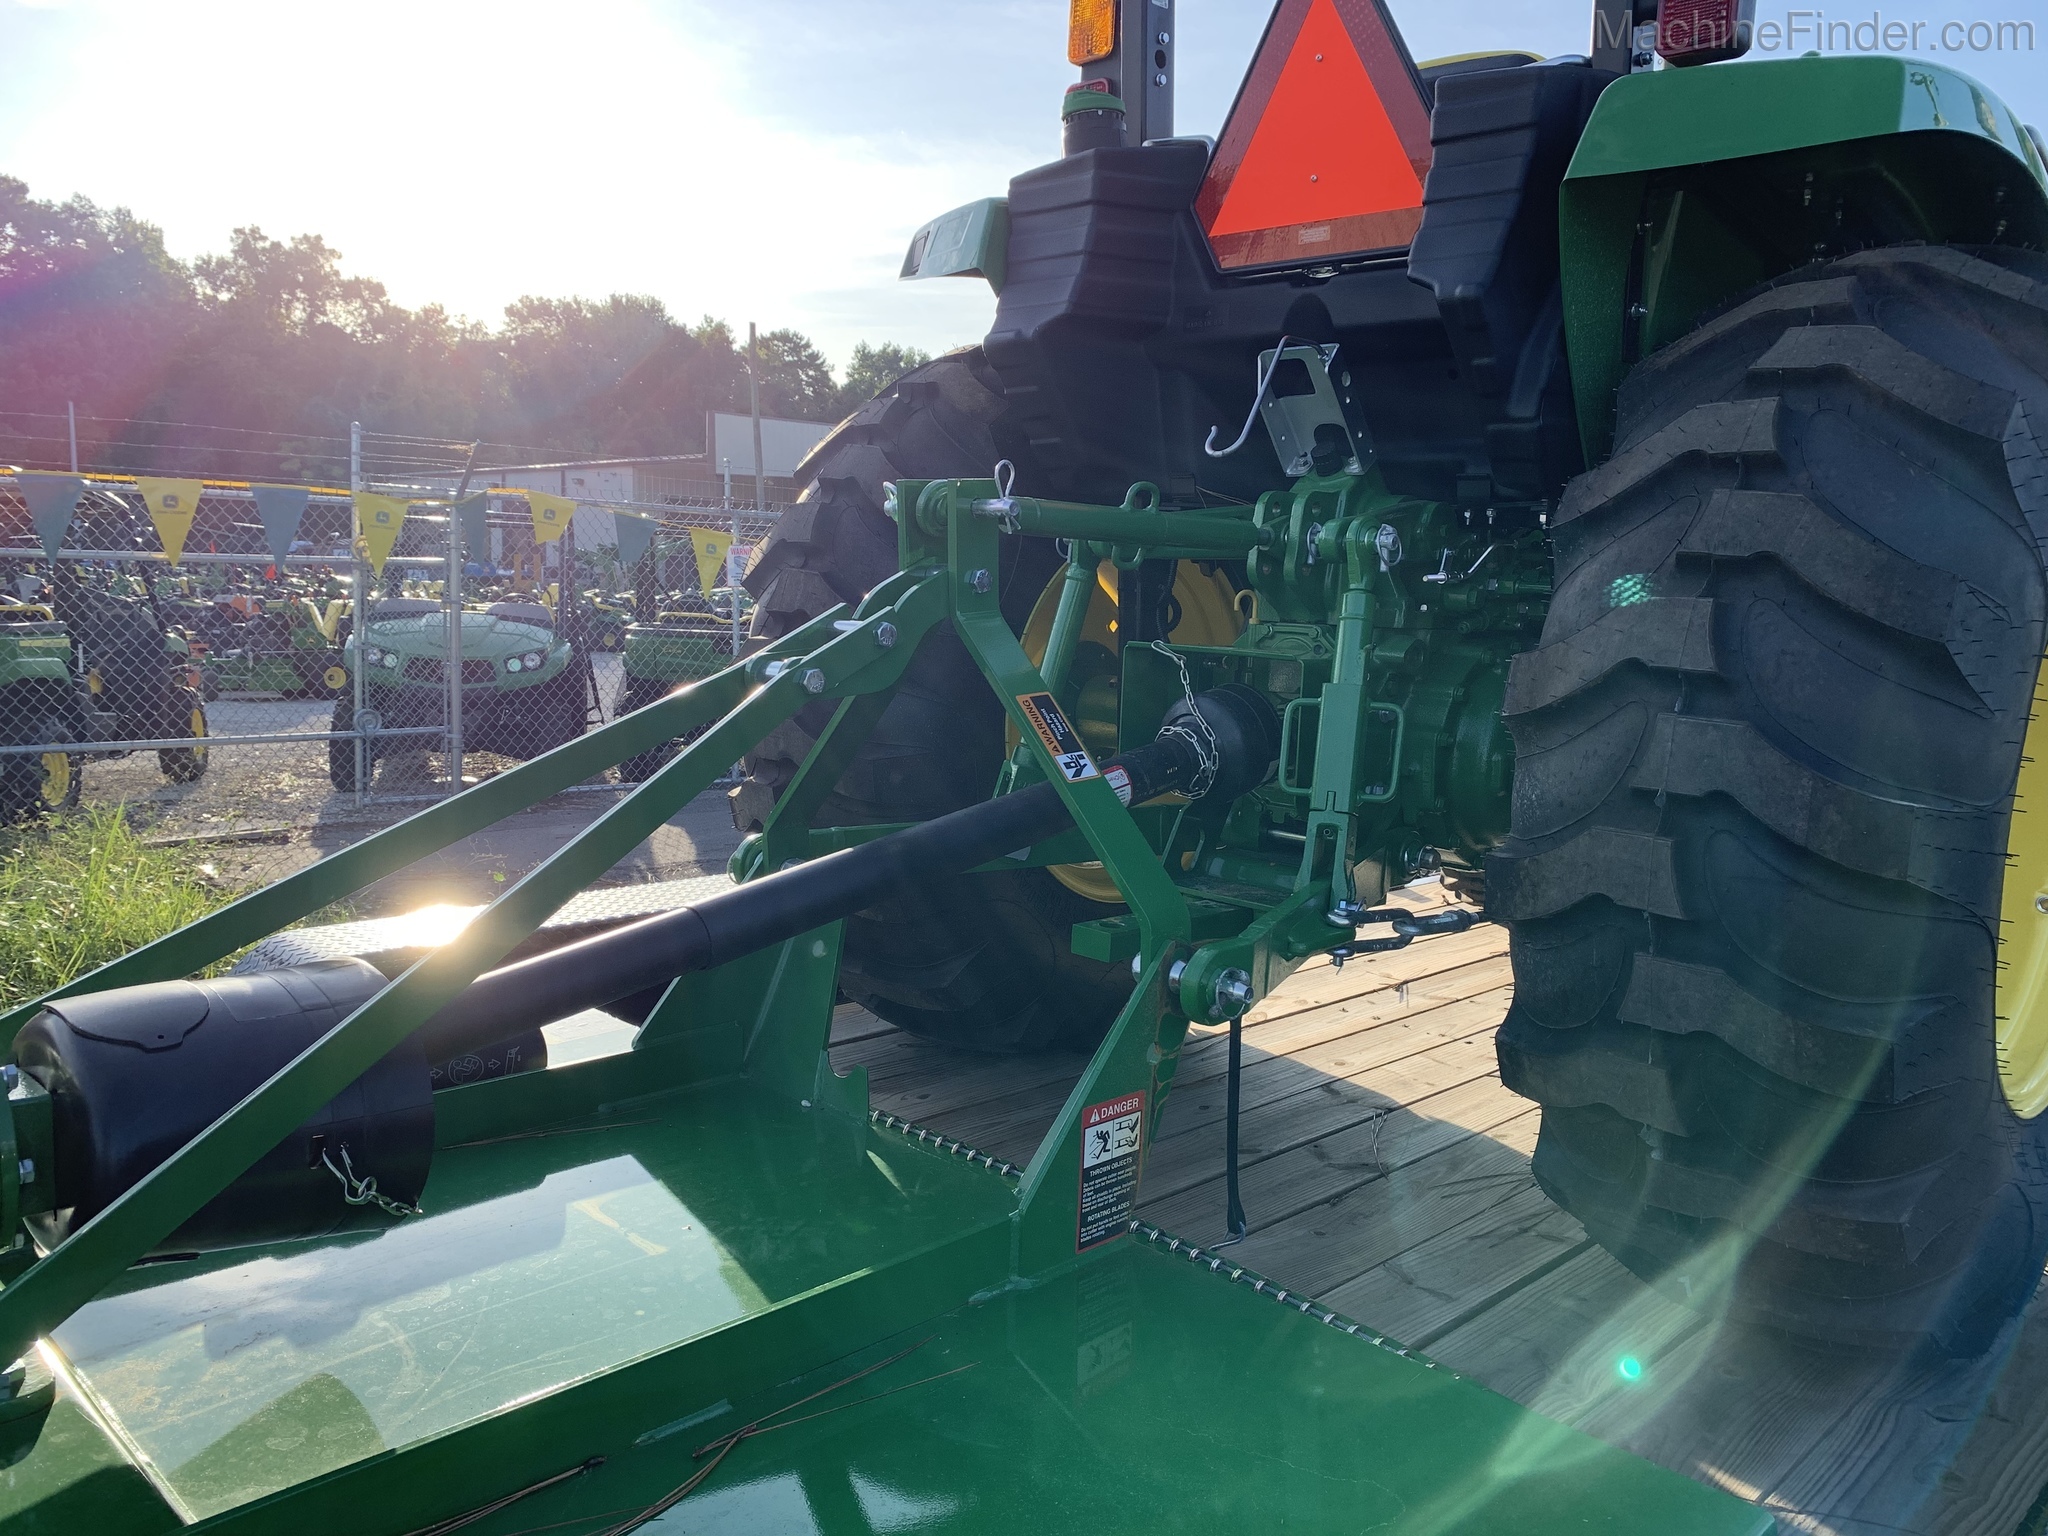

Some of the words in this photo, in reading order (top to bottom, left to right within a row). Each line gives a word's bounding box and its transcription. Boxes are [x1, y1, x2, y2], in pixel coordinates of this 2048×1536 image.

[1023, 700, 1054, 745] WARNING
[1041, 708, 1052, 723] Point
[1051, 724, 1063, 740] Pinch
[1102, 1098, 1139, 1118] DANGER
[1090, 1165, 1110, 1177] THROWN
[1111, 1157, 1132, 1169] OBJECTS
[1088, 1209, 1110, 1222] ROTATING
[1112, 1201, 1130, 1213] BLADES
